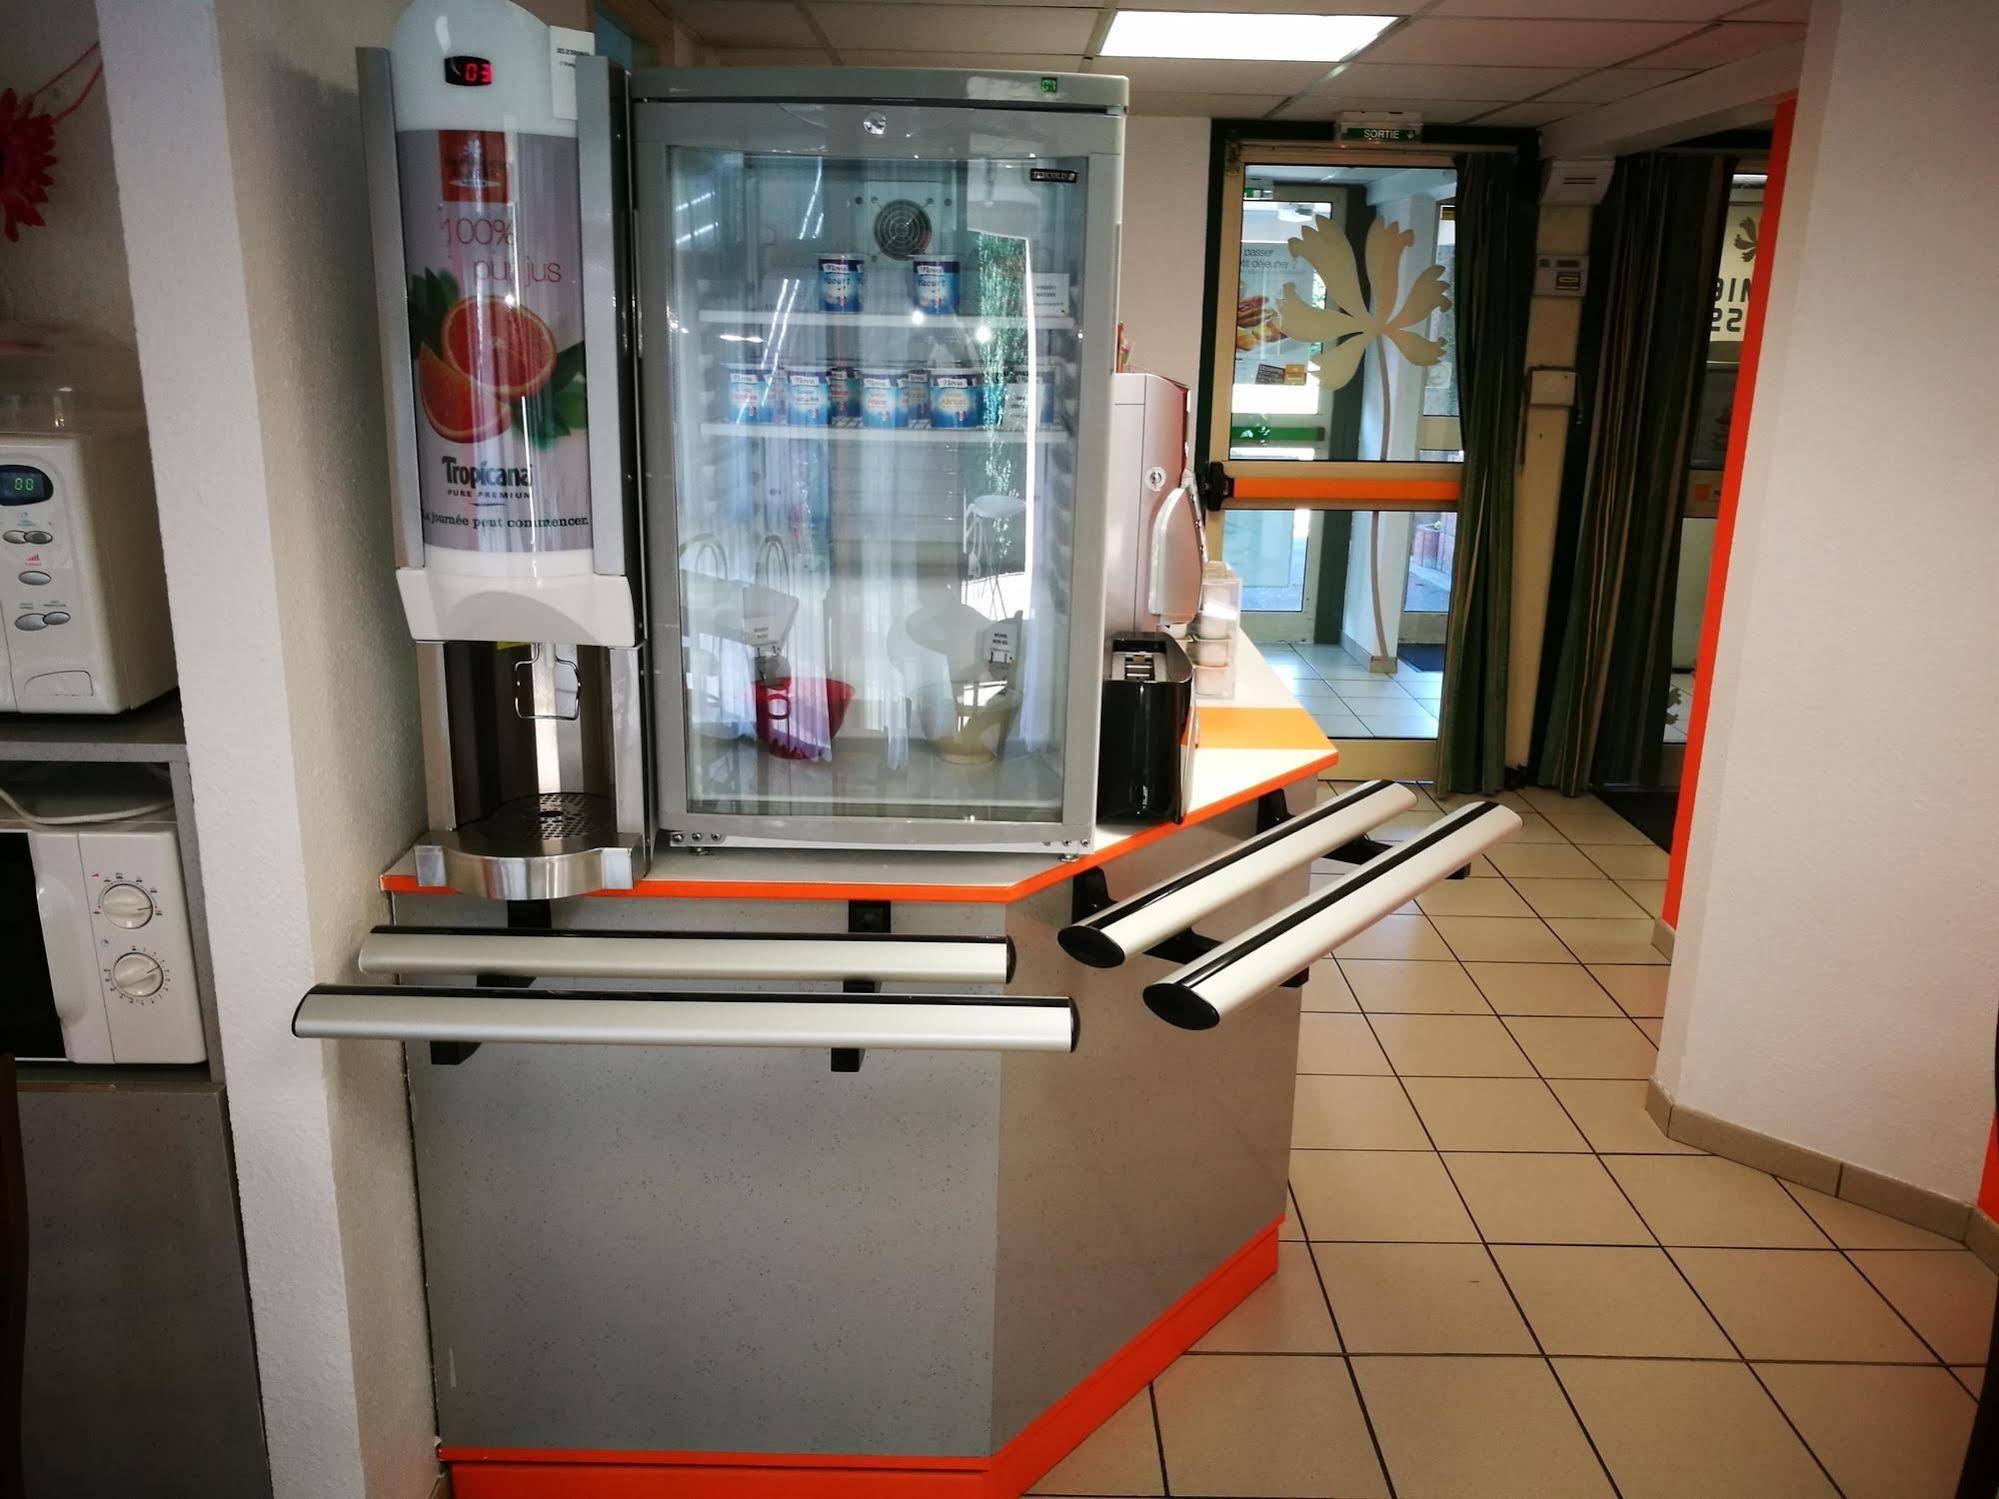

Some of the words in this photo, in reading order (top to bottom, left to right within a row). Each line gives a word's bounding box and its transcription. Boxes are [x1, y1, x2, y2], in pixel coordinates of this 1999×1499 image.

[1363, 128, 1400, 140] SORTIE
[443, 218, 514, 245] 100%
[524, 256, 562, 288] jus
[442, 456, 534, 489] Tropicana
[448, 489, 473, 498] PURE
[473, 516, 503, 530] peut
